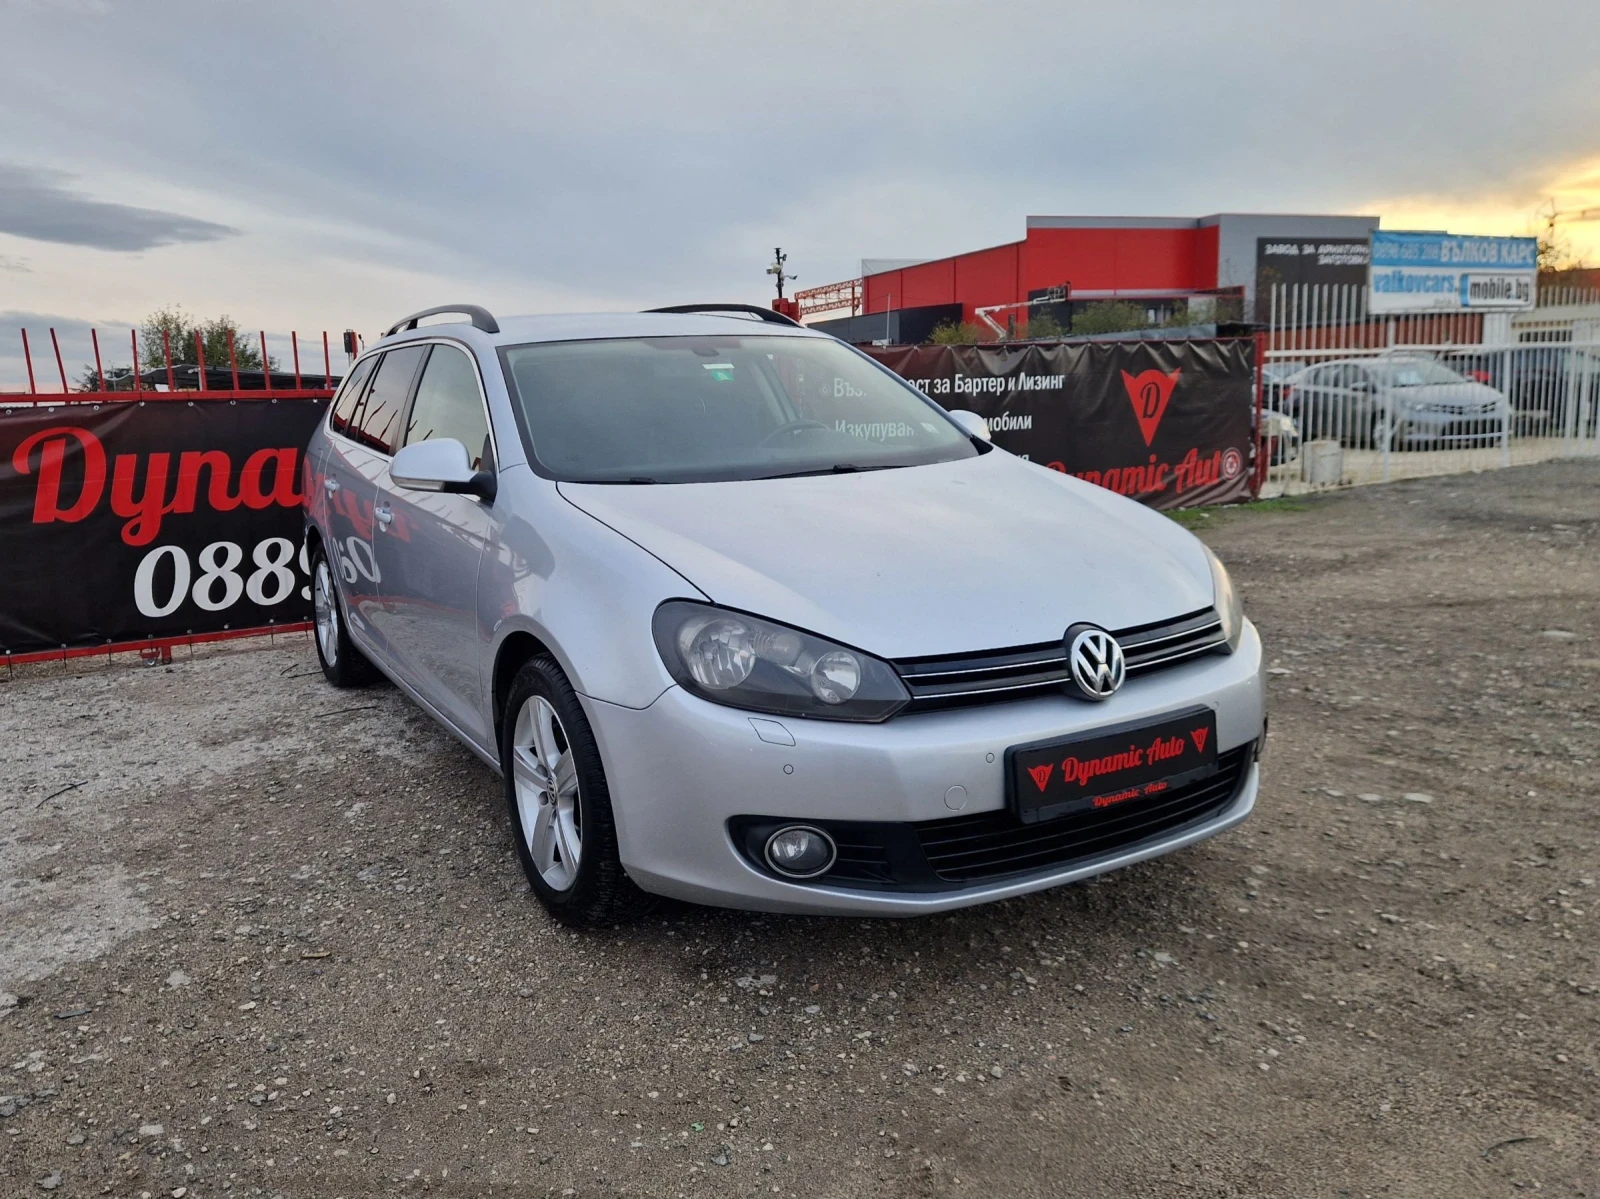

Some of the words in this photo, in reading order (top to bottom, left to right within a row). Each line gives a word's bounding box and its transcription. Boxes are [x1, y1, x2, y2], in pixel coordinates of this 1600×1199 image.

[1301, 243, 1316, 255] ЗА
[1440, 240, 1498, 263] ВЪЛКОВ
[1500, 243, 1535, 264] КАРС
[1470, 277, 1530, 302] mobile.bg
[933, 378, 951, 394] за
[954, 373, 1005, 397] Бартер
[1007, 377, 1015, 391] и
[1018, 371, 1065, 391] Лизинг
[12, 427, 304, 547] Dyna
[1061, 744, 1143, 787] Dynamic
[1146, 736, 1186, 766] Auto
[1092, 788, 1140, 808] Dynamic
[1144, 780, 1169, 795] Auto
